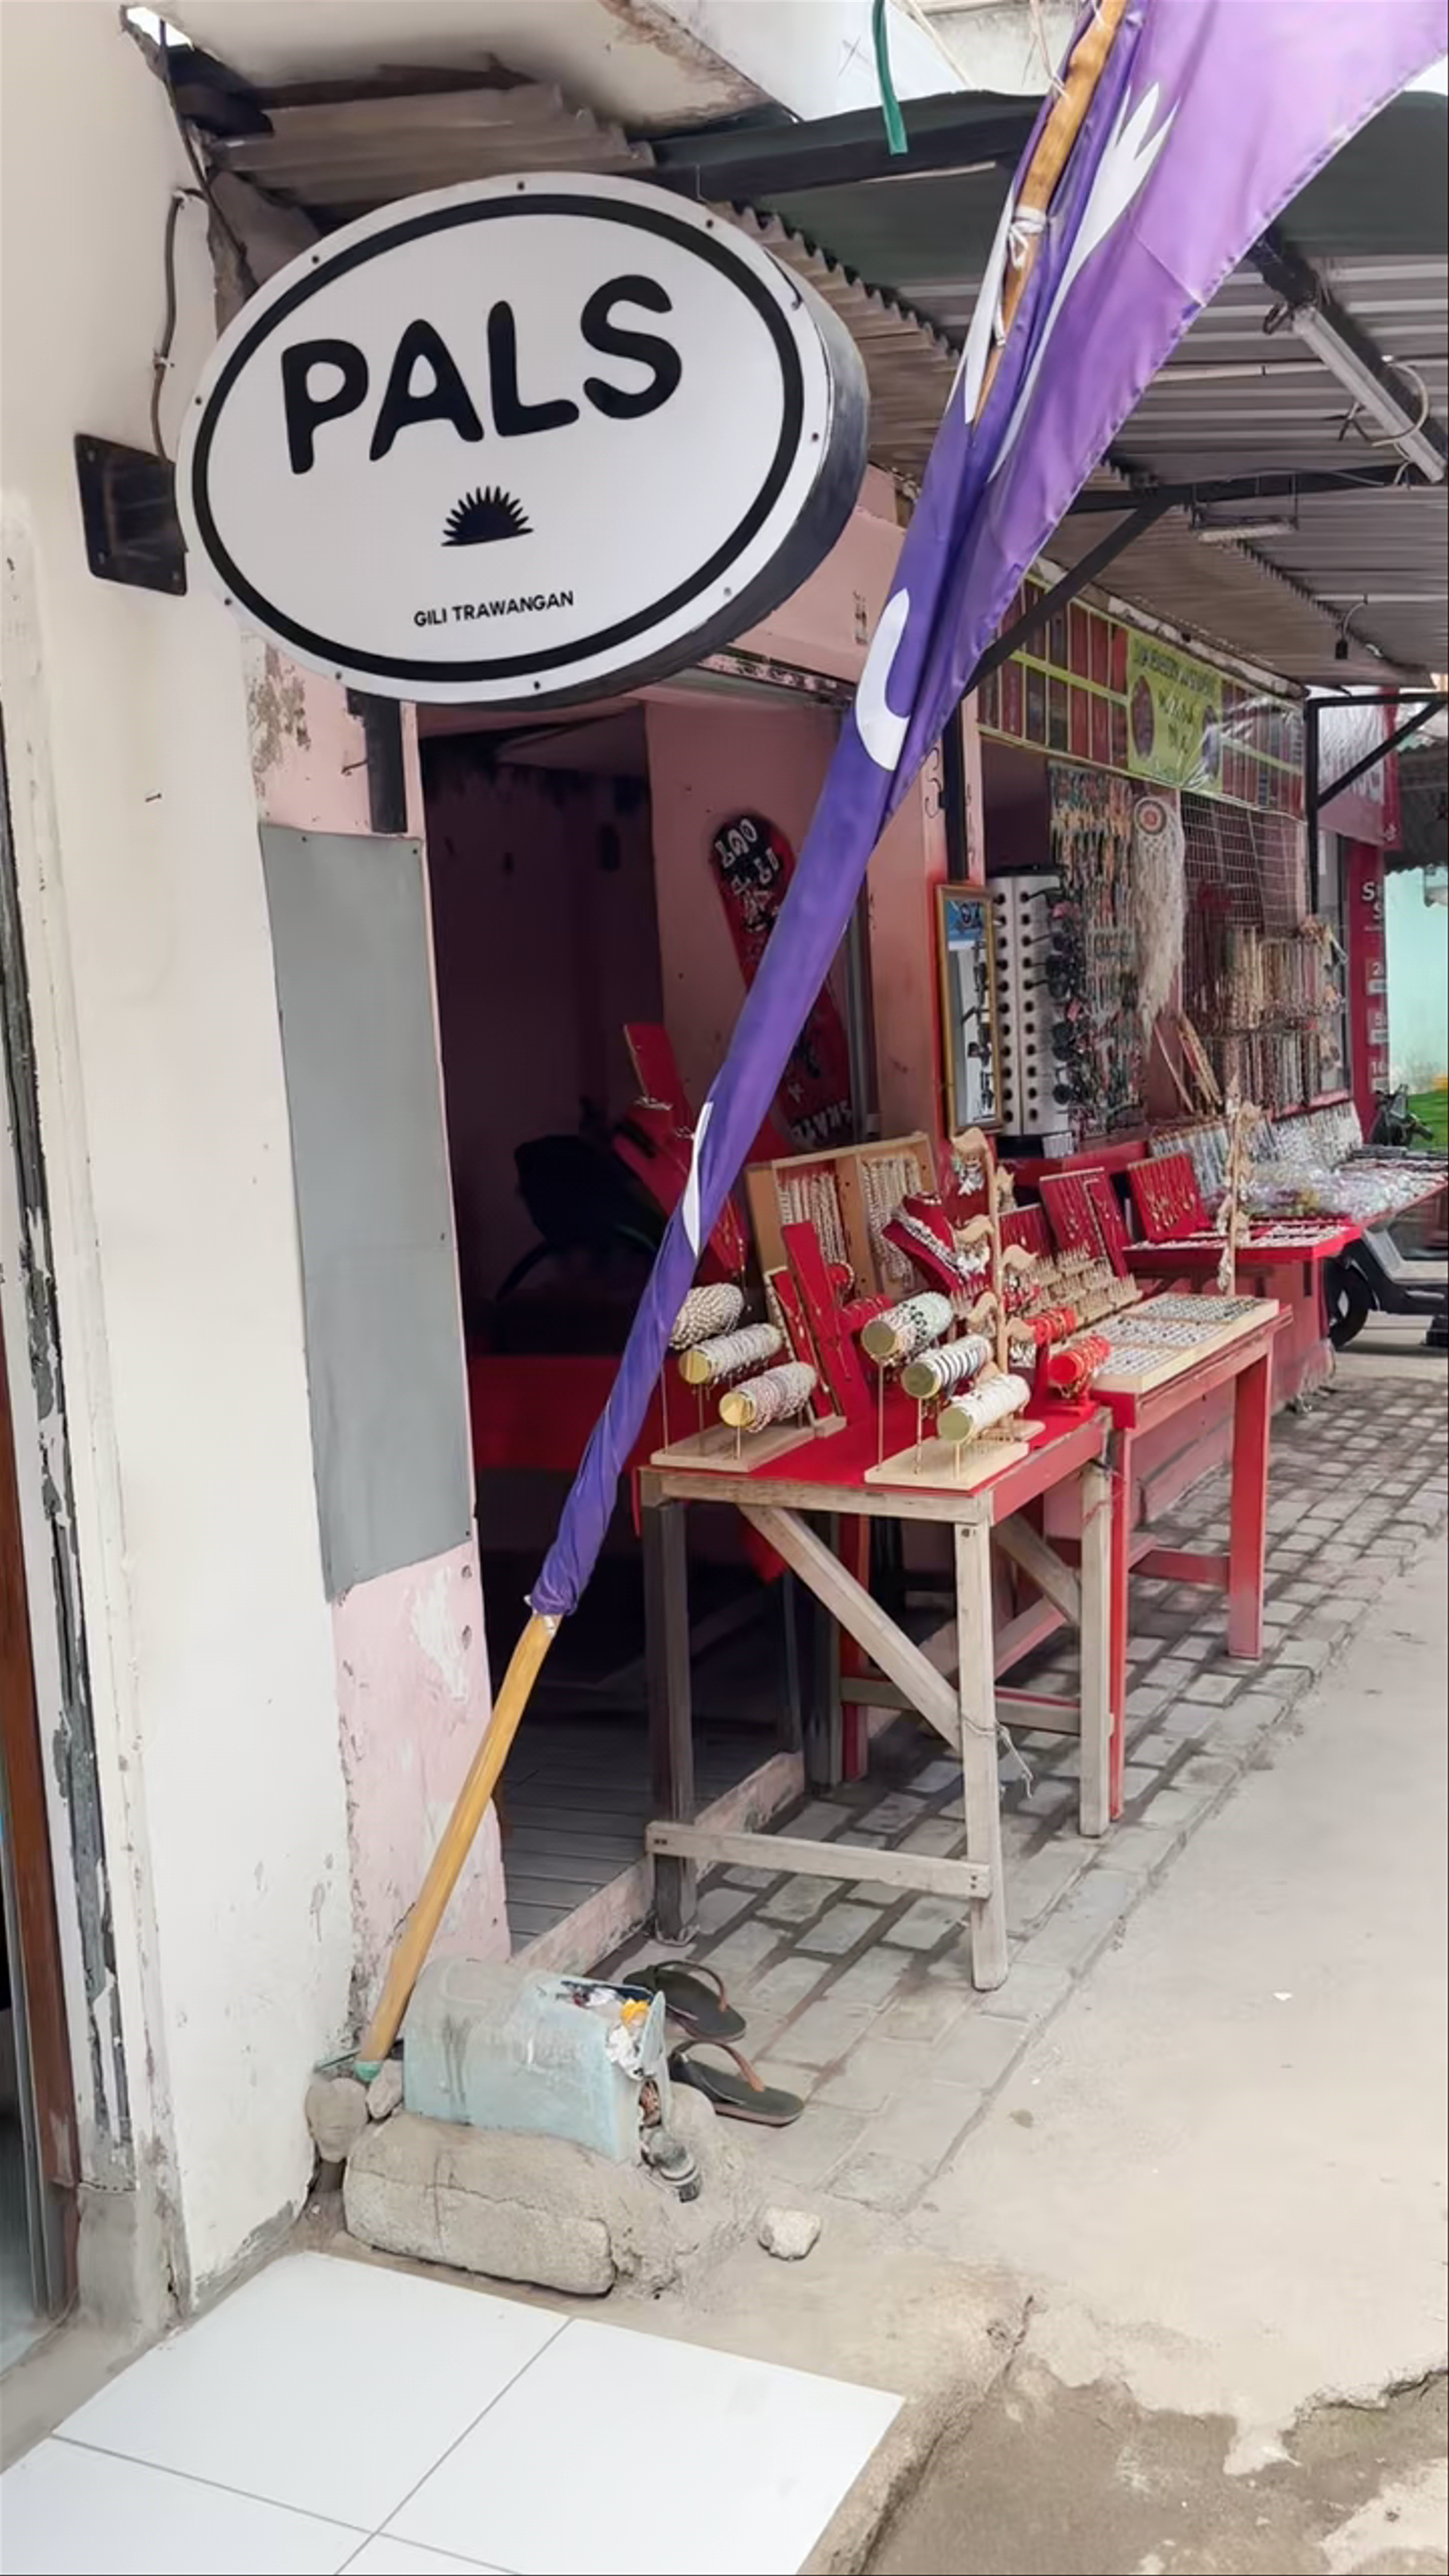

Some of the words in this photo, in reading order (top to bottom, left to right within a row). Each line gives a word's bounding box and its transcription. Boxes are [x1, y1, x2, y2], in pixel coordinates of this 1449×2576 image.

[281, 274, 683, 475] PALS
[413, 608, 447, 627] GILI
[452, 591, 574, 621] TRAWANGAN
